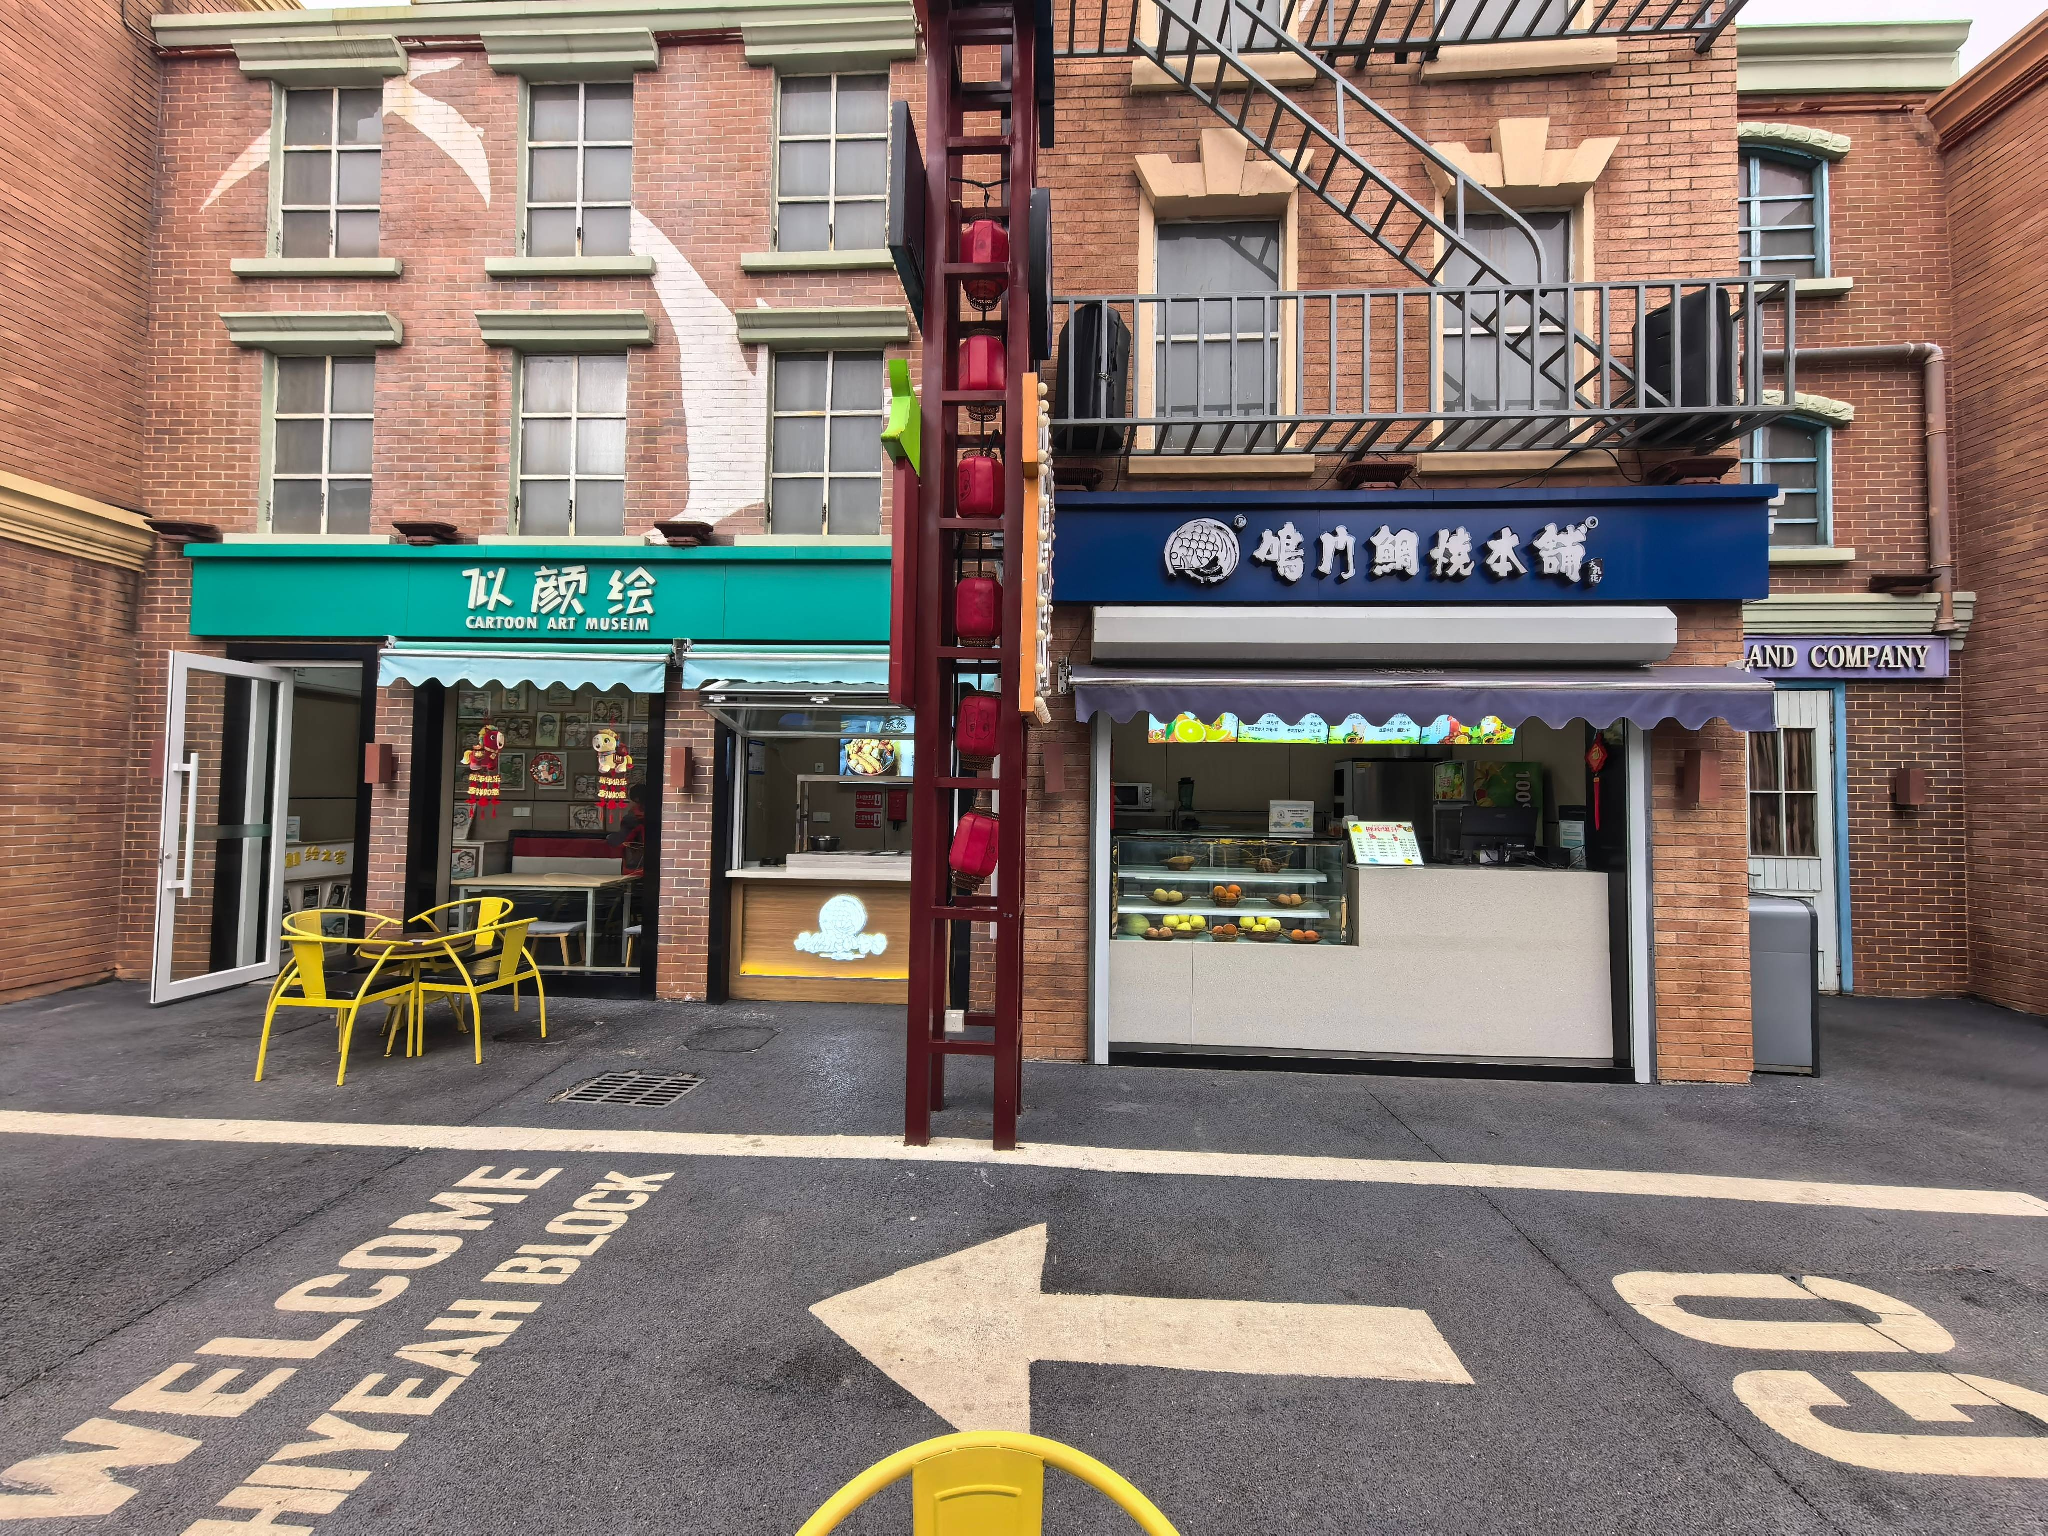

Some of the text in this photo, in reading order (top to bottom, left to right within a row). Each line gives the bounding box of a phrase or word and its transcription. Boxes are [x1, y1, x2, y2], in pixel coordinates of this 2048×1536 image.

[462, 564, 657, 615] 似颜绘
[465, 615, 649, 632] CARTOON ART MUSEIM
[1749, 644, 1931, 668] AND COMPANY
[1515, 771, 1532, 807] 100
[481, 1170, 676, 1285] BLOCK
[0, 1165, 563, 1520] WELCOME
[1612, 1271, 2048, 1478] GO
